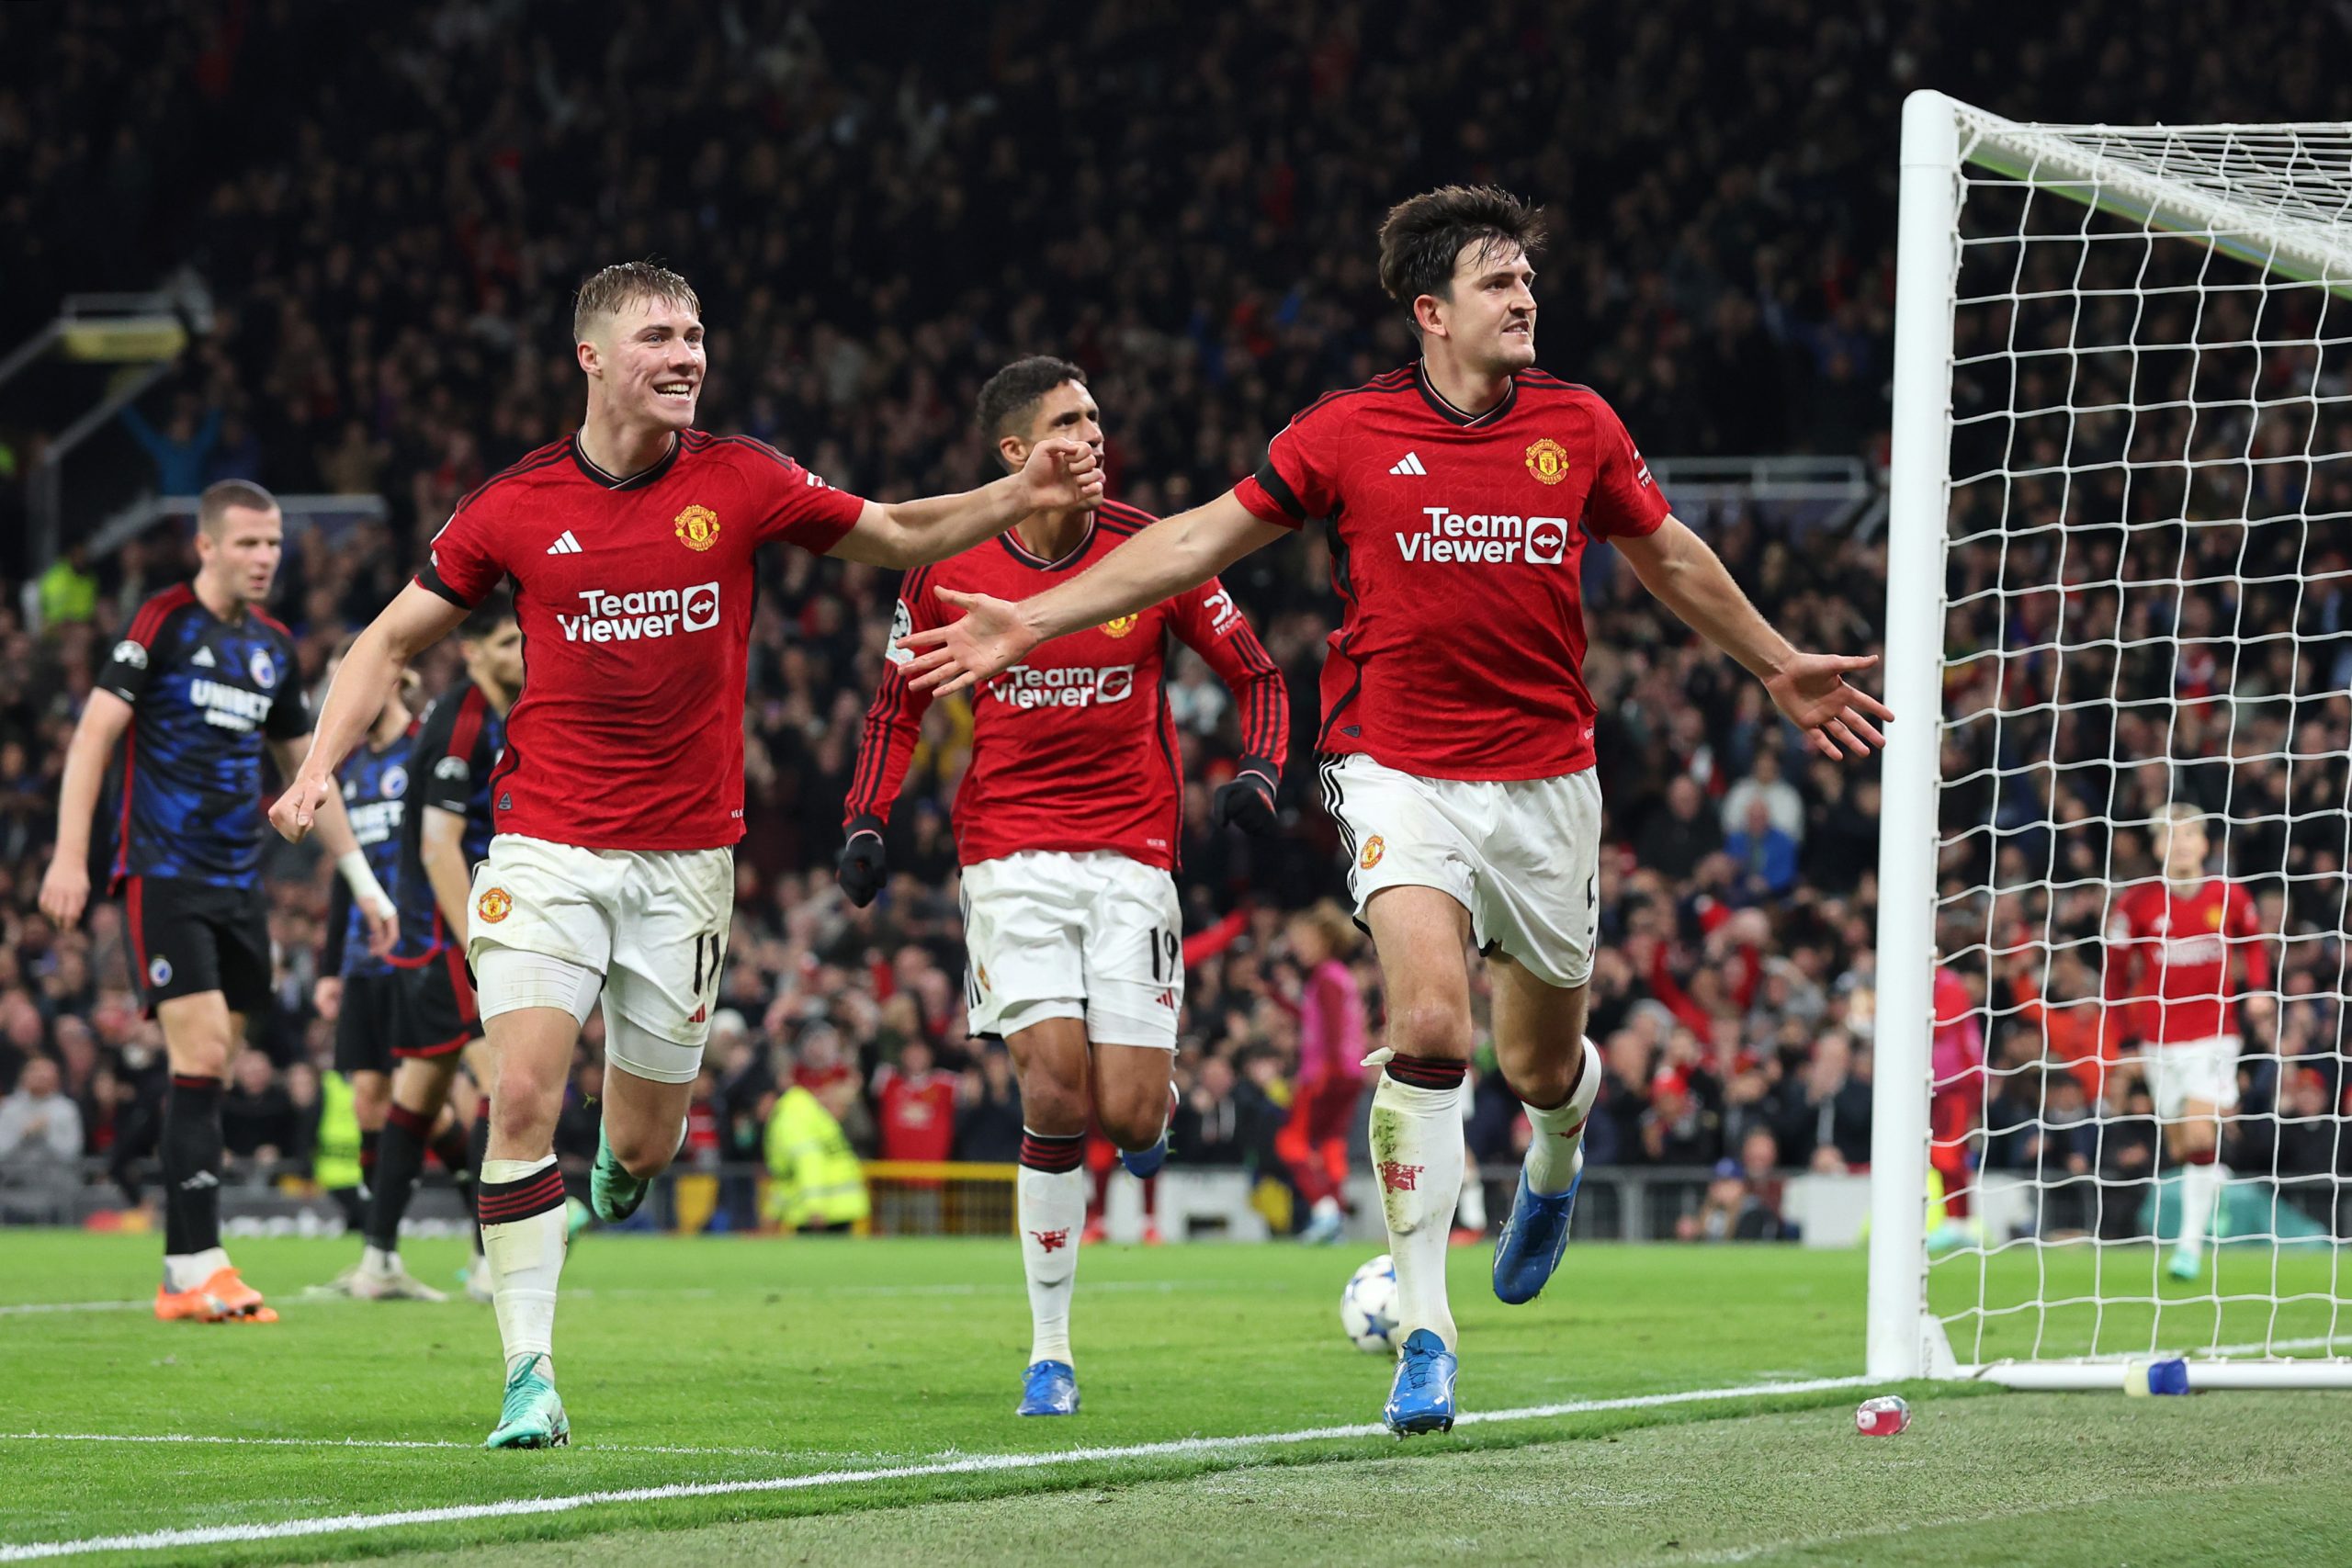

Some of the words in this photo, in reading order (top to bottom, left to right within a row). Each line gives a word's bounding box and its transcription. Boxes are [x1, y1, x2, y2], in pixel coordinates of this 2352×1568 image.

[1529, 441, 1566, 457] MANCHESTER
[1537, 472, 1562, 483] UNITED
[678, 506, 715, 525] MANCHESTER
[1423, 507, 1522, 538] Team
[689, 537, 714, 548] UNITED
[1396, 532, 1521, 563] Viewer
[579, 589, 679, 618] Team
[557, 613, 679, 642] Viewer
[1006, 664, 1095, 688] Team
[190, 678, 273, 723] UNIBET
[988, 680, 1095, 709] Viewer
[693, 932, 720, 998] 11
[1148, 925, 1179, 985] 19
